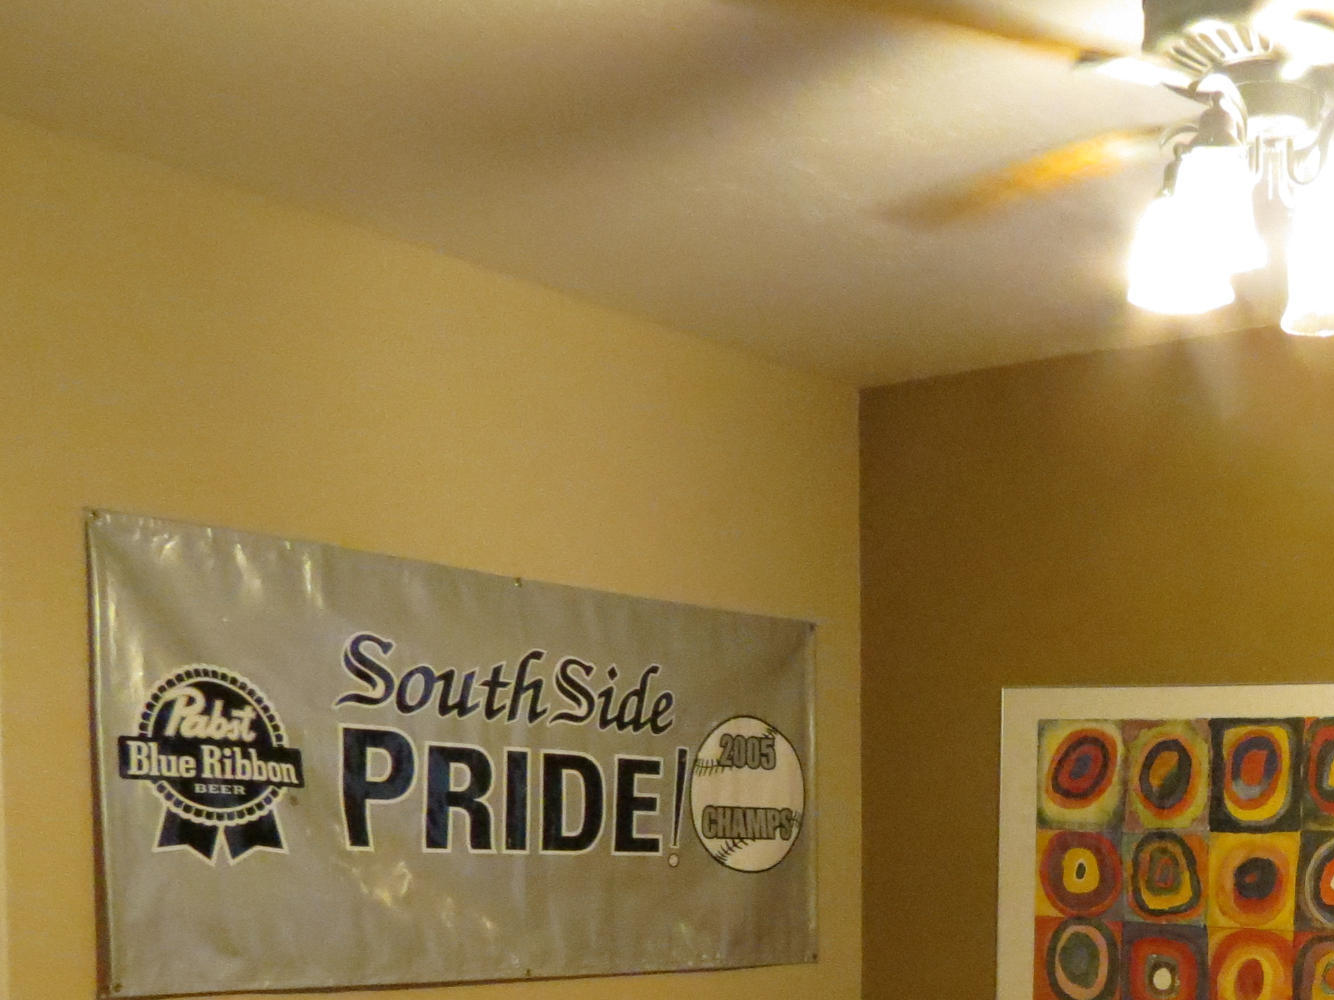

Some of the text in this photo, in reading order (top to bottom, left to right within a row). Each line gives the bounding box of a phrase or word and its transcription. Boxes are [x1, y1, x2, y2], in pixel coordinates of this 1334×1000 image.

[155, 685, 257, 742] Pabst
[126, 740, 300, 784] Blue Ribbon
[718, 733, 777, 770] 2005
[193, 783, 247, 796] BEER
[338, 723, 691, 868] PRIDE!
[701, 804, 794, 841] CHAMPS
